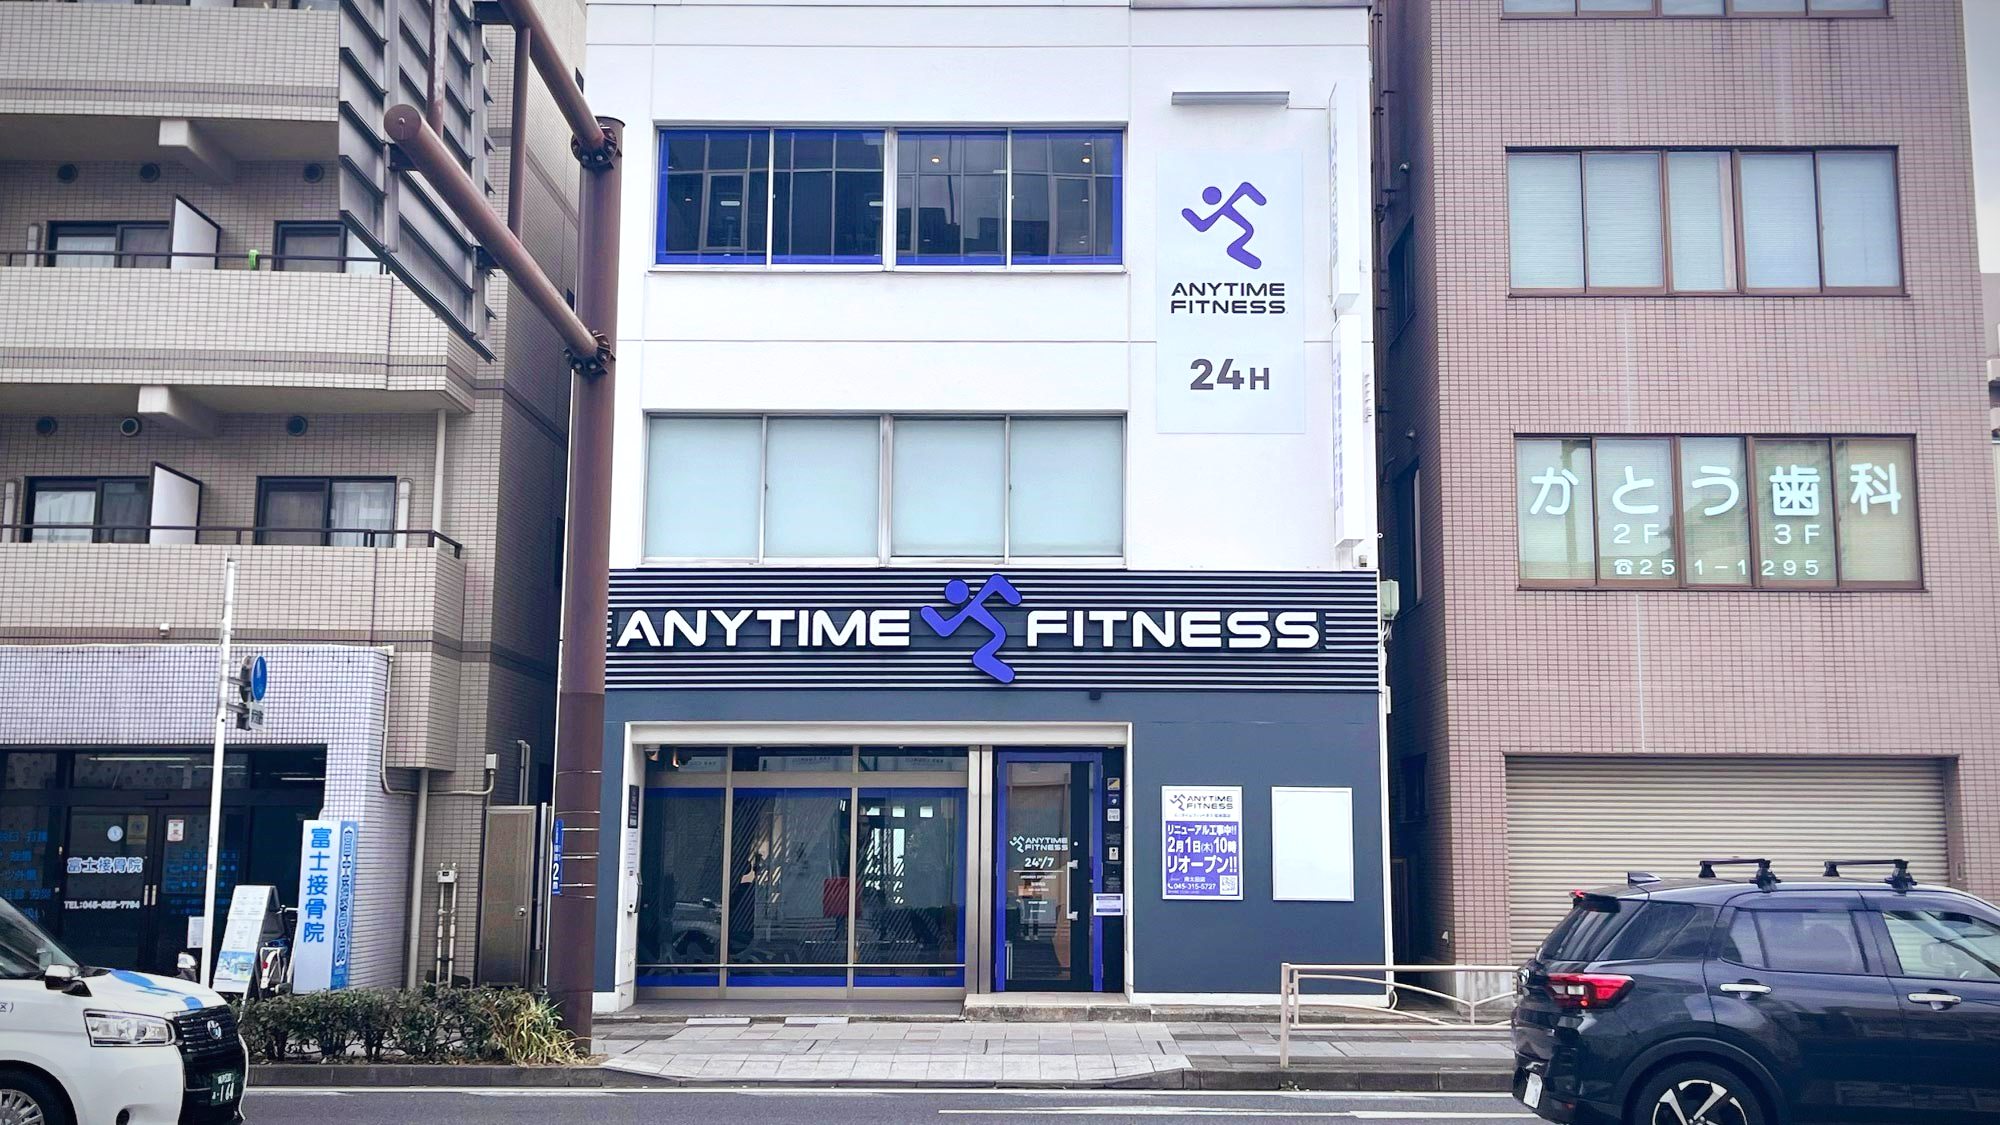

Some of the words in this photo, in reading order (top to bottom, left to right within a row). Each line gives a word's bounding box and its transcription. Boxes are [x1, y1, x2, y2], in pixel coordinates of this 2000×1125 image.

[1171, 282, 1285, 297] ANYTIME
[1170, 299, 1286, 314] FITNESS
[1190, 358, 1270, 391] 24H
[1529, 462, 1902, 517] かとう歯科
[1612, 523, 1660, 544] 2F
[1774, 523, 1821, 545] 3F
[616, 609, 910, 647] ANYTIME
[1027, 610, 1320, 648] FITNESS
[67, 857, 143, 873] 富士接骨院
[303, 826, 333, 944] 富士接骨院
